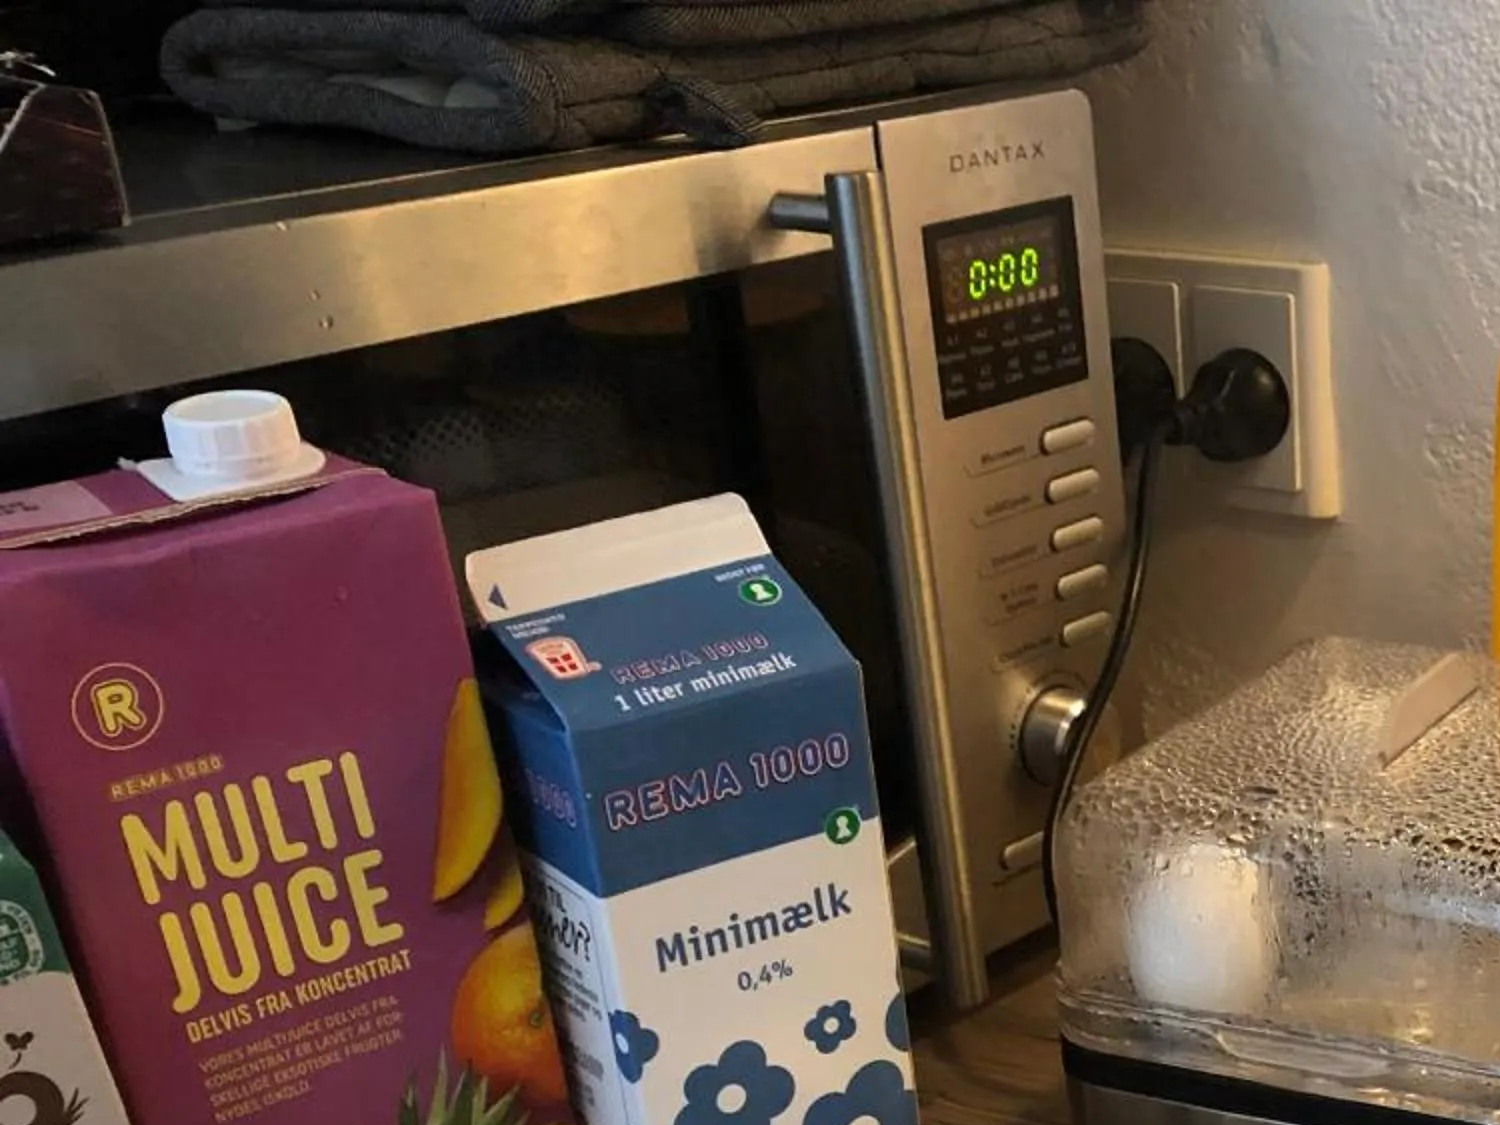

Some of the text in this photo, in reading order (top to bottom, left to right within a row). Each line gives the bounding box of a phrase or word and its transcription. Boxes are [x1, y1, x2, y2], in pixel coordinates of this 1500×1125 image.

[949, 141, 1046, 174] DANTAX
[968, 247, 1039, 300] 0:00
[609, 631, 769, 686] REMA 1000
[614, 652, 798, 711] 1 liter minimælk
[93, 679, 147, 738] R
[603, 733, 853, 833] REMA 1000
[120, 751, 377, 906] MULTI
[158, 848, 405, 1016] JUICE
[655, 882, 852, 973] Minimælk
[186, 949, 413, 1044] DELVIS FRA KONCENTRAT
[737, 959, 794, 992] 0,4%
